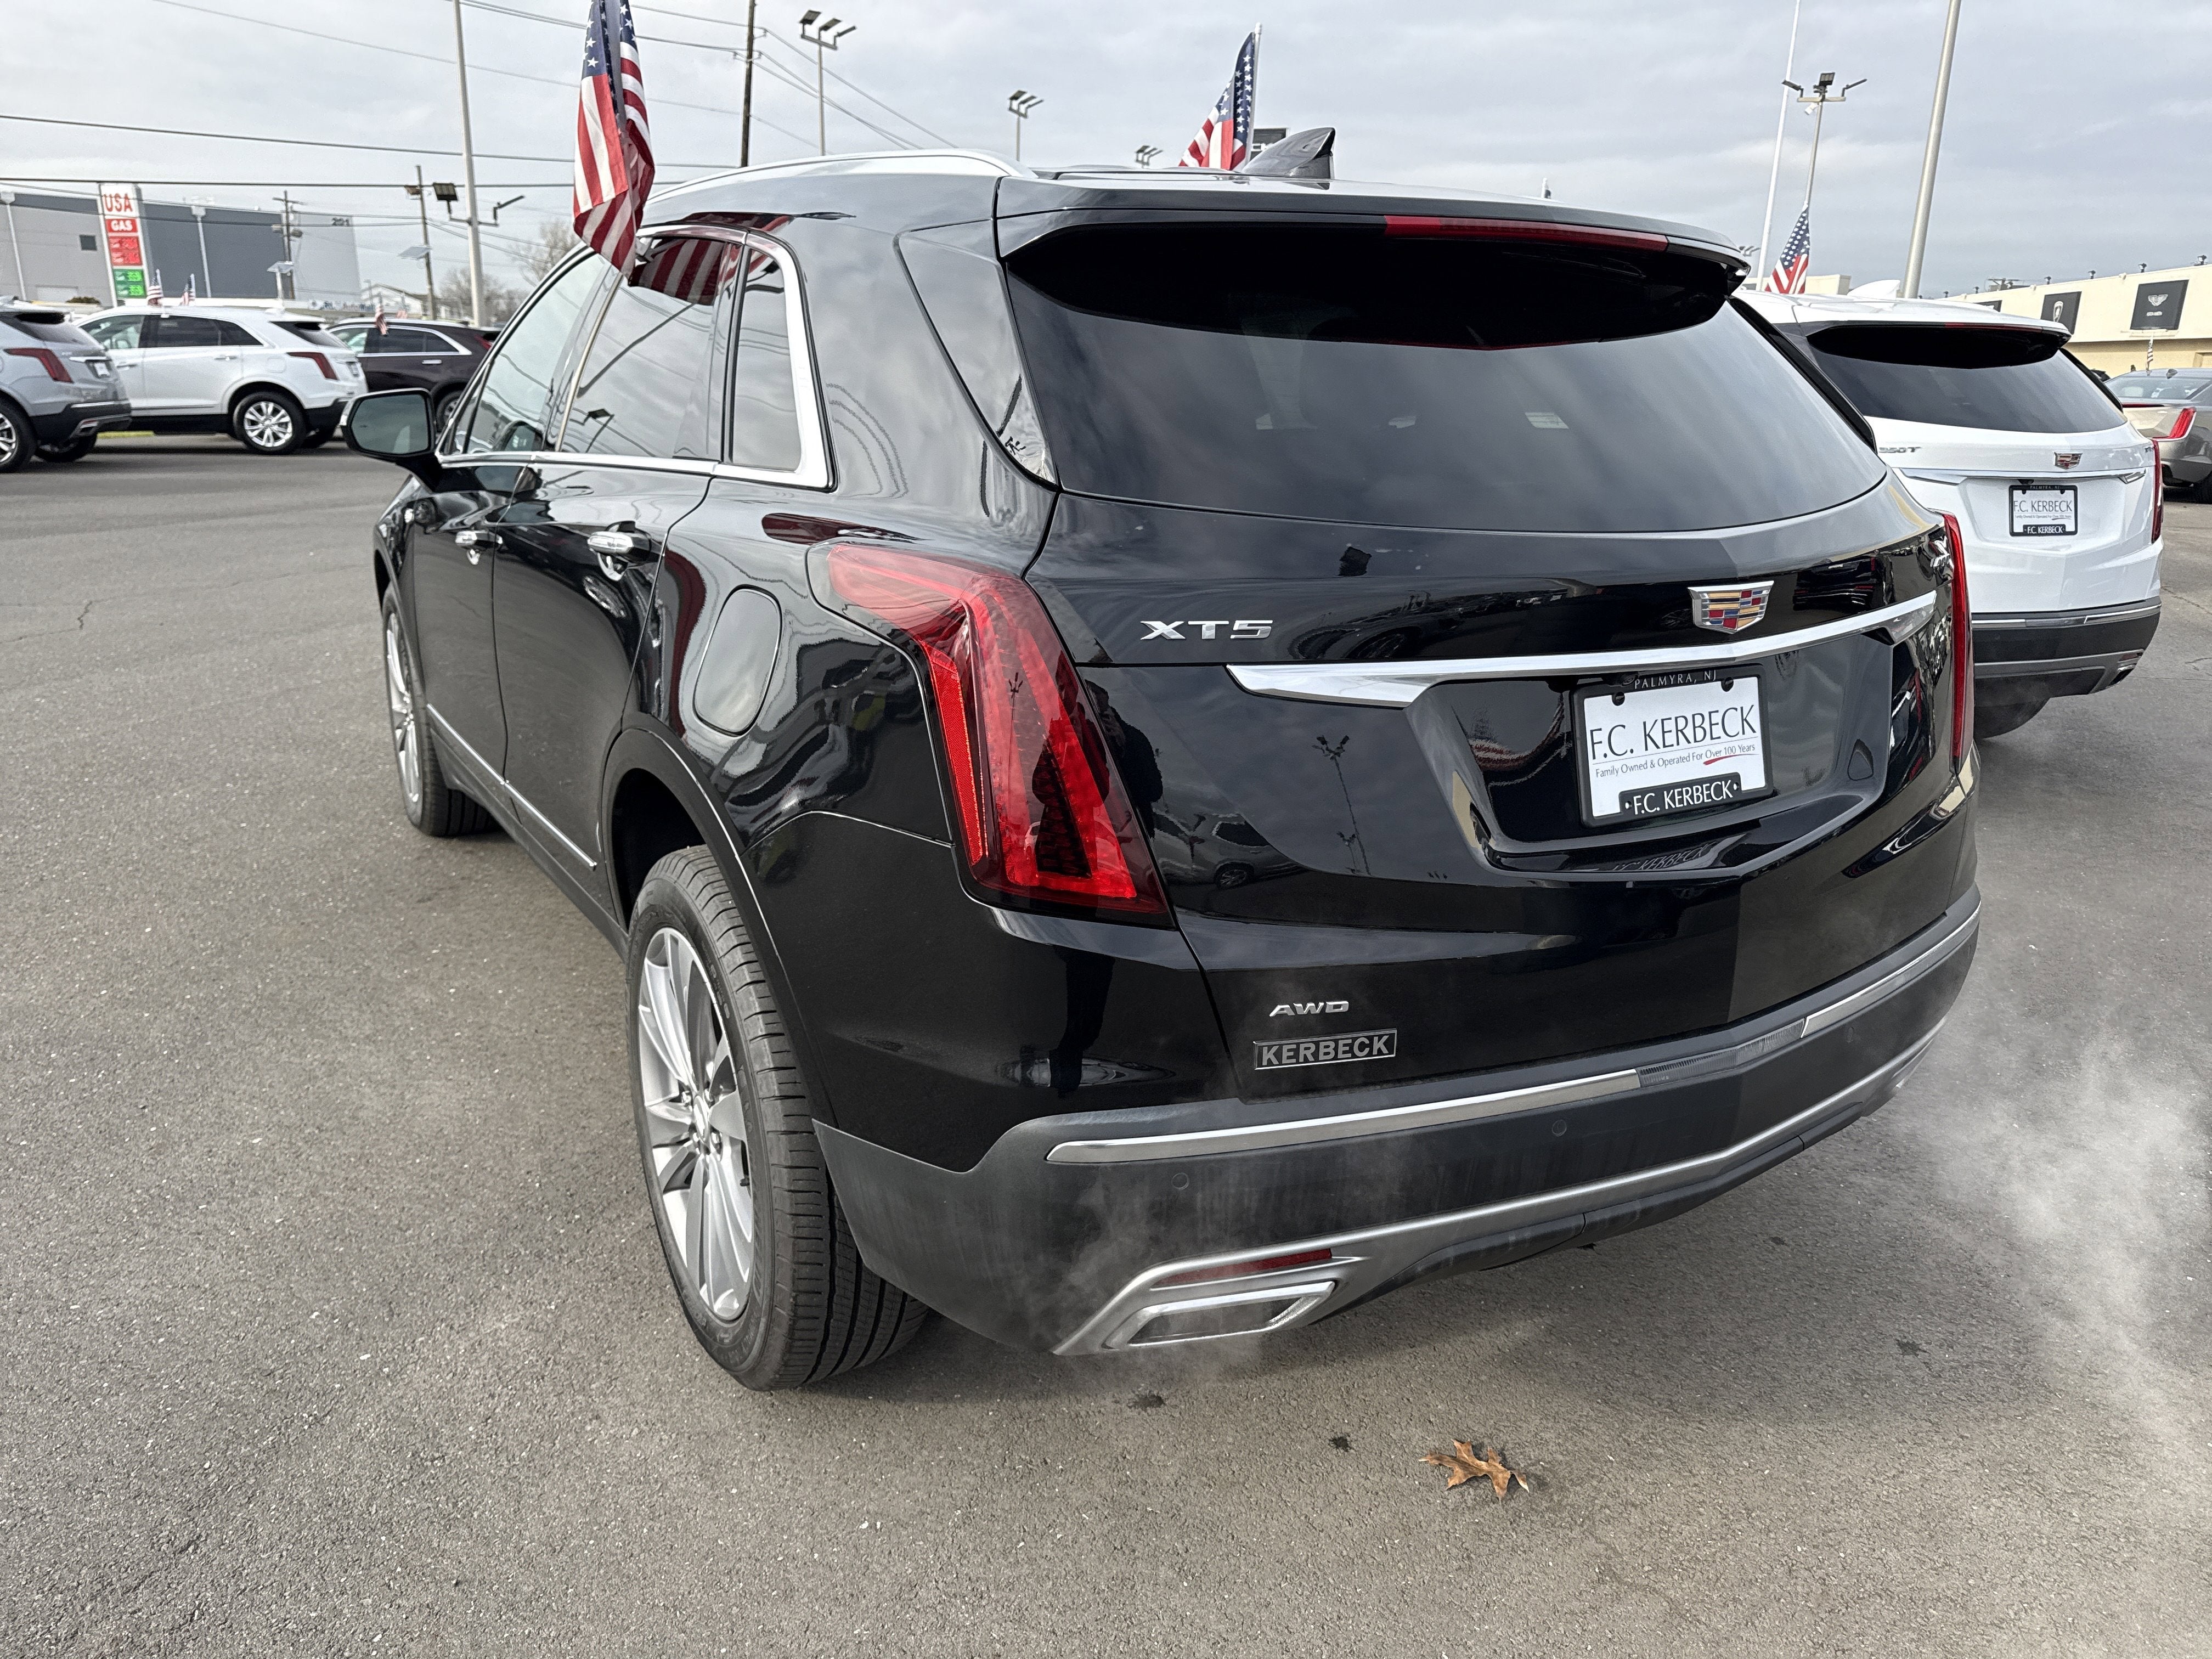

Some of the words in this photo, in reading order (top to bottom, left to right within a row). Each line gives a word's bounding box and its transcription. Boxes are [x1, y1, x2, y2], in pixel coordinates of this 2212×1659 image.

[103, 193, 133, 212] USA
[111, 219, 133, 231] GAS
[2013, 500, 2028, 512] F.C.
[2031, 500, 2072, 512] KERBECK
[1140, 620, 1273, 640] XT5
[1634, 673, 1696, 689] PALMYRA,
[1704, 670, 1716, 681] NJ
[1590, 724, 1634, 760] F.C.
[1643, 704, 1757, 751] KERBECK
[1596, 765, 1619, 777] Family
[1621, 760, 1647, 774] Owned
[1650, 759, 1655, 768] &
[1657, 753, 1690, 768] Operated
[1692, 752, 1703, 763] For
[1705, 749, 1722, 759] Over
[1724, 746, 1736, 755] 100
[1738, 744, 1755, 753] Years
[1633, 793, 1660, 815] F.C.
[1664, 780, 1733, 809] KERBECK
[1269, 1001, 1349, 1017] AWD
[1262, 1035, 1389, 1066] KERBECK
